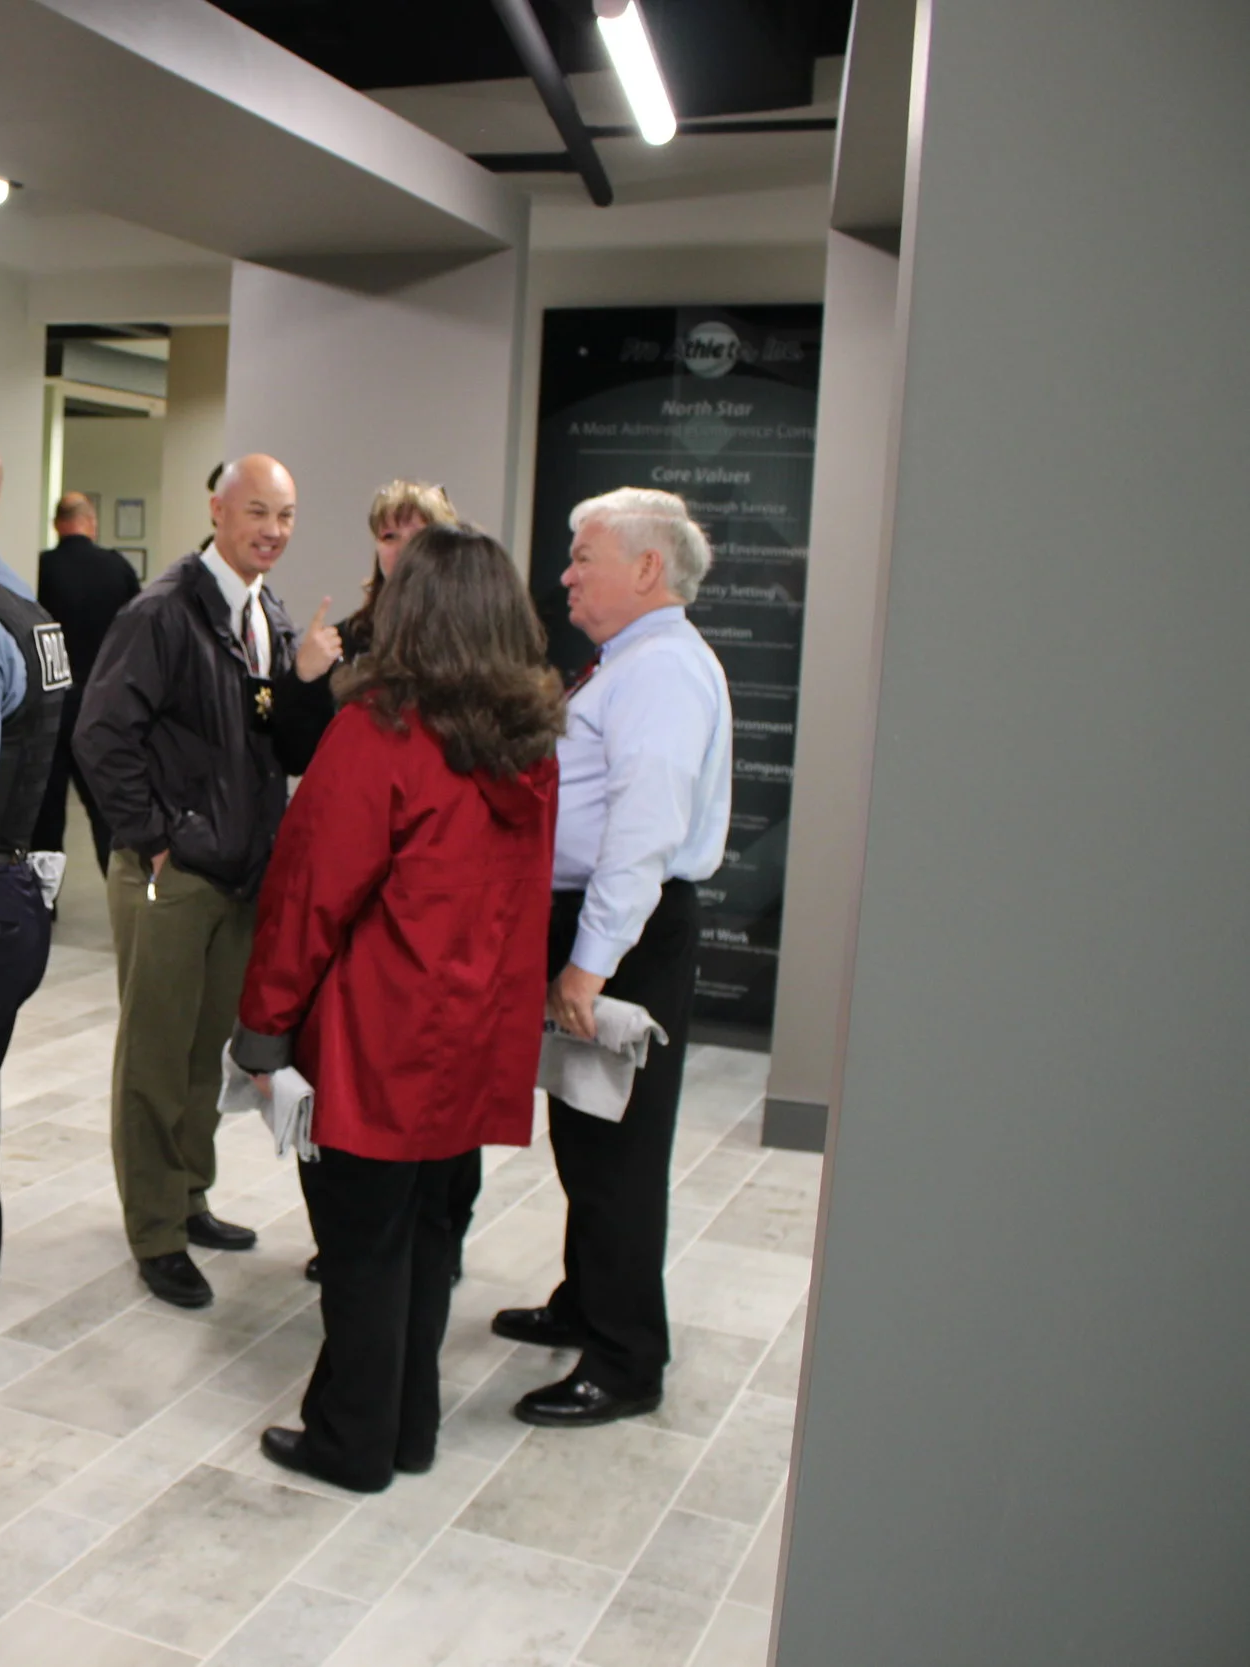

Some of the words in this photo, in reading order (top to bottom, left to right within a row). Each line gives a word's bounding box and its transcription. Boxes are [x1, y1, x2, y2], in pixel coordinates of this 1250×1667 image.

[661, 401, 713, 417] North
[718, 401, 754, 417] Star
[569, 422, 580, 436] A
[583, 422, 618, 436] Most
[652, 466, 692, 483] Core
[695, 467, 752, 485] Values
